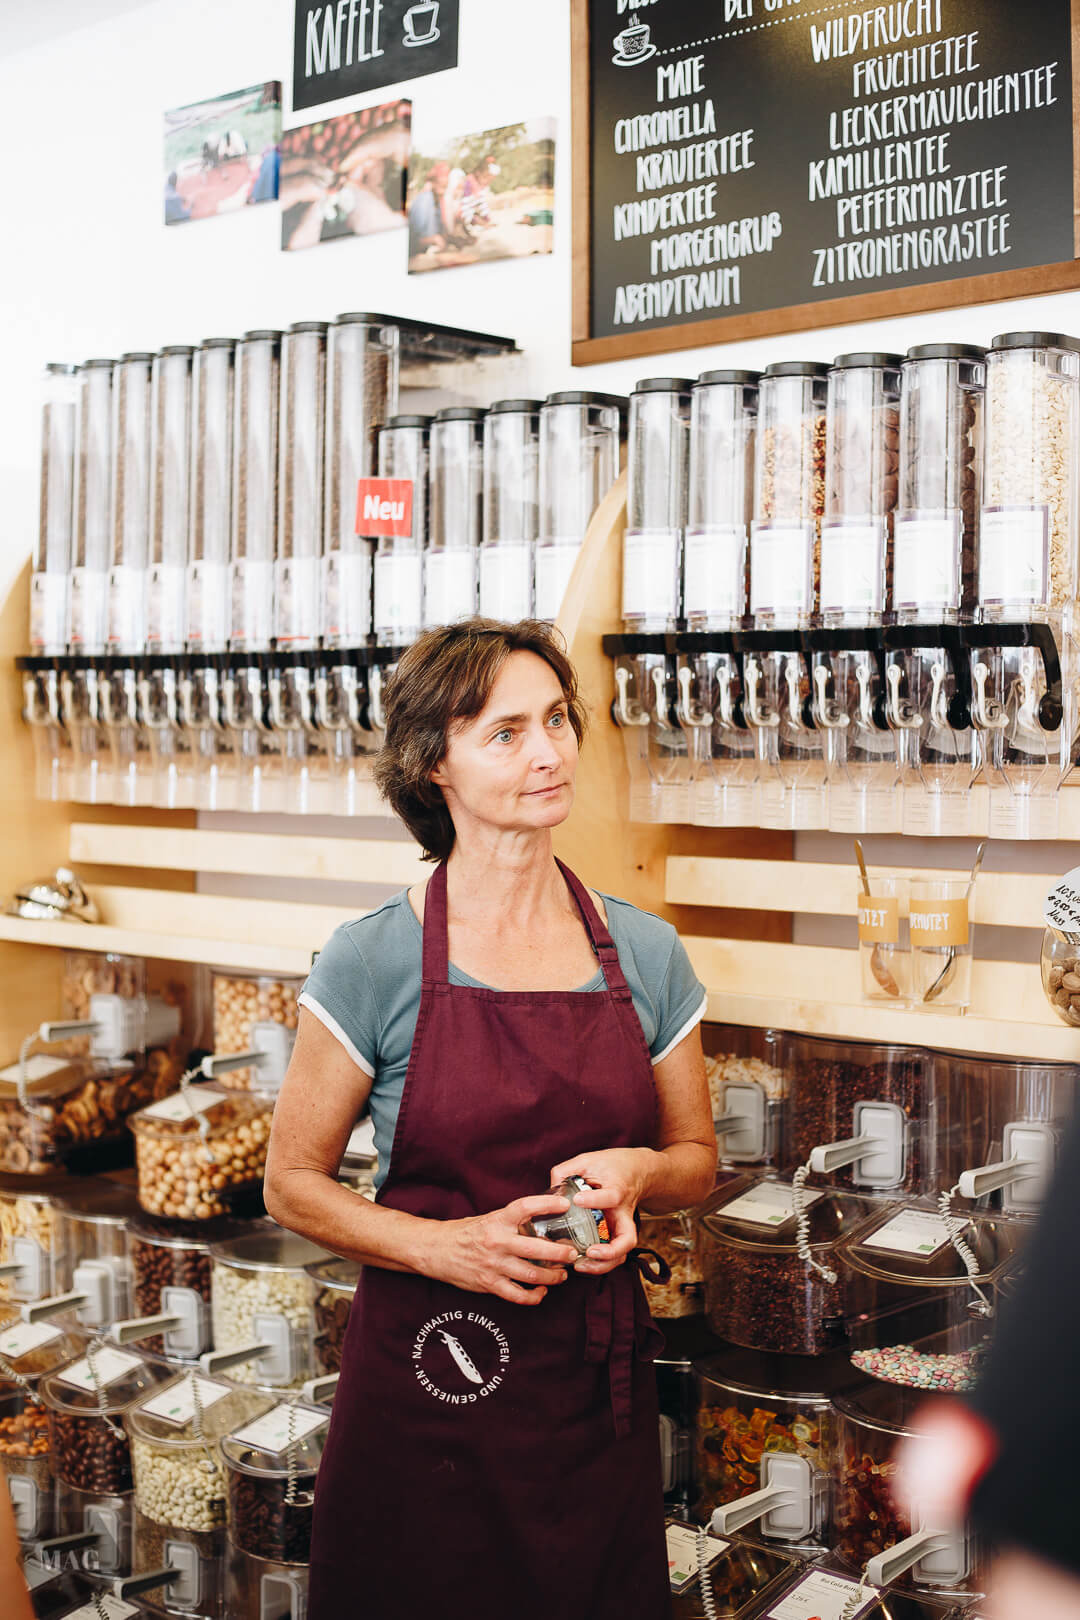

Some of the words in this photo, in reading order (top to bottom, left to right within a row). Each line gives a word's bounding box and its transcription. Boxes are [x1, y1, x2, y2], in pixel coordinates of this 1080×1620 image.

[305, 0, 385, 78] KAFFEE
[852, 31, 981, 98] FRÜCHTETEE
[656, 54, 705, 102] MATE
[614, 99, 717, 154] CITRONELLA
[636, 128, 756, 193] KRÄUTERTEE
[808, 132, 952, 202] KAMILLENTEE
[613, 181, 718, 241] KINDERTEE
[811, 212, 1013, 288] ZITRONENGRASTEE
[612, 265, 741, 326] ABENDTRAUM
[363, 495, 405, 521] Neu
[412, 1310, 463, 1359] NACHHALTIG
[467, 1312, 510, 1363] EINKAUFEN
[415, 1370, 477, 1404] GENIESSEN
[480, 1375, 503, 1396] UND
